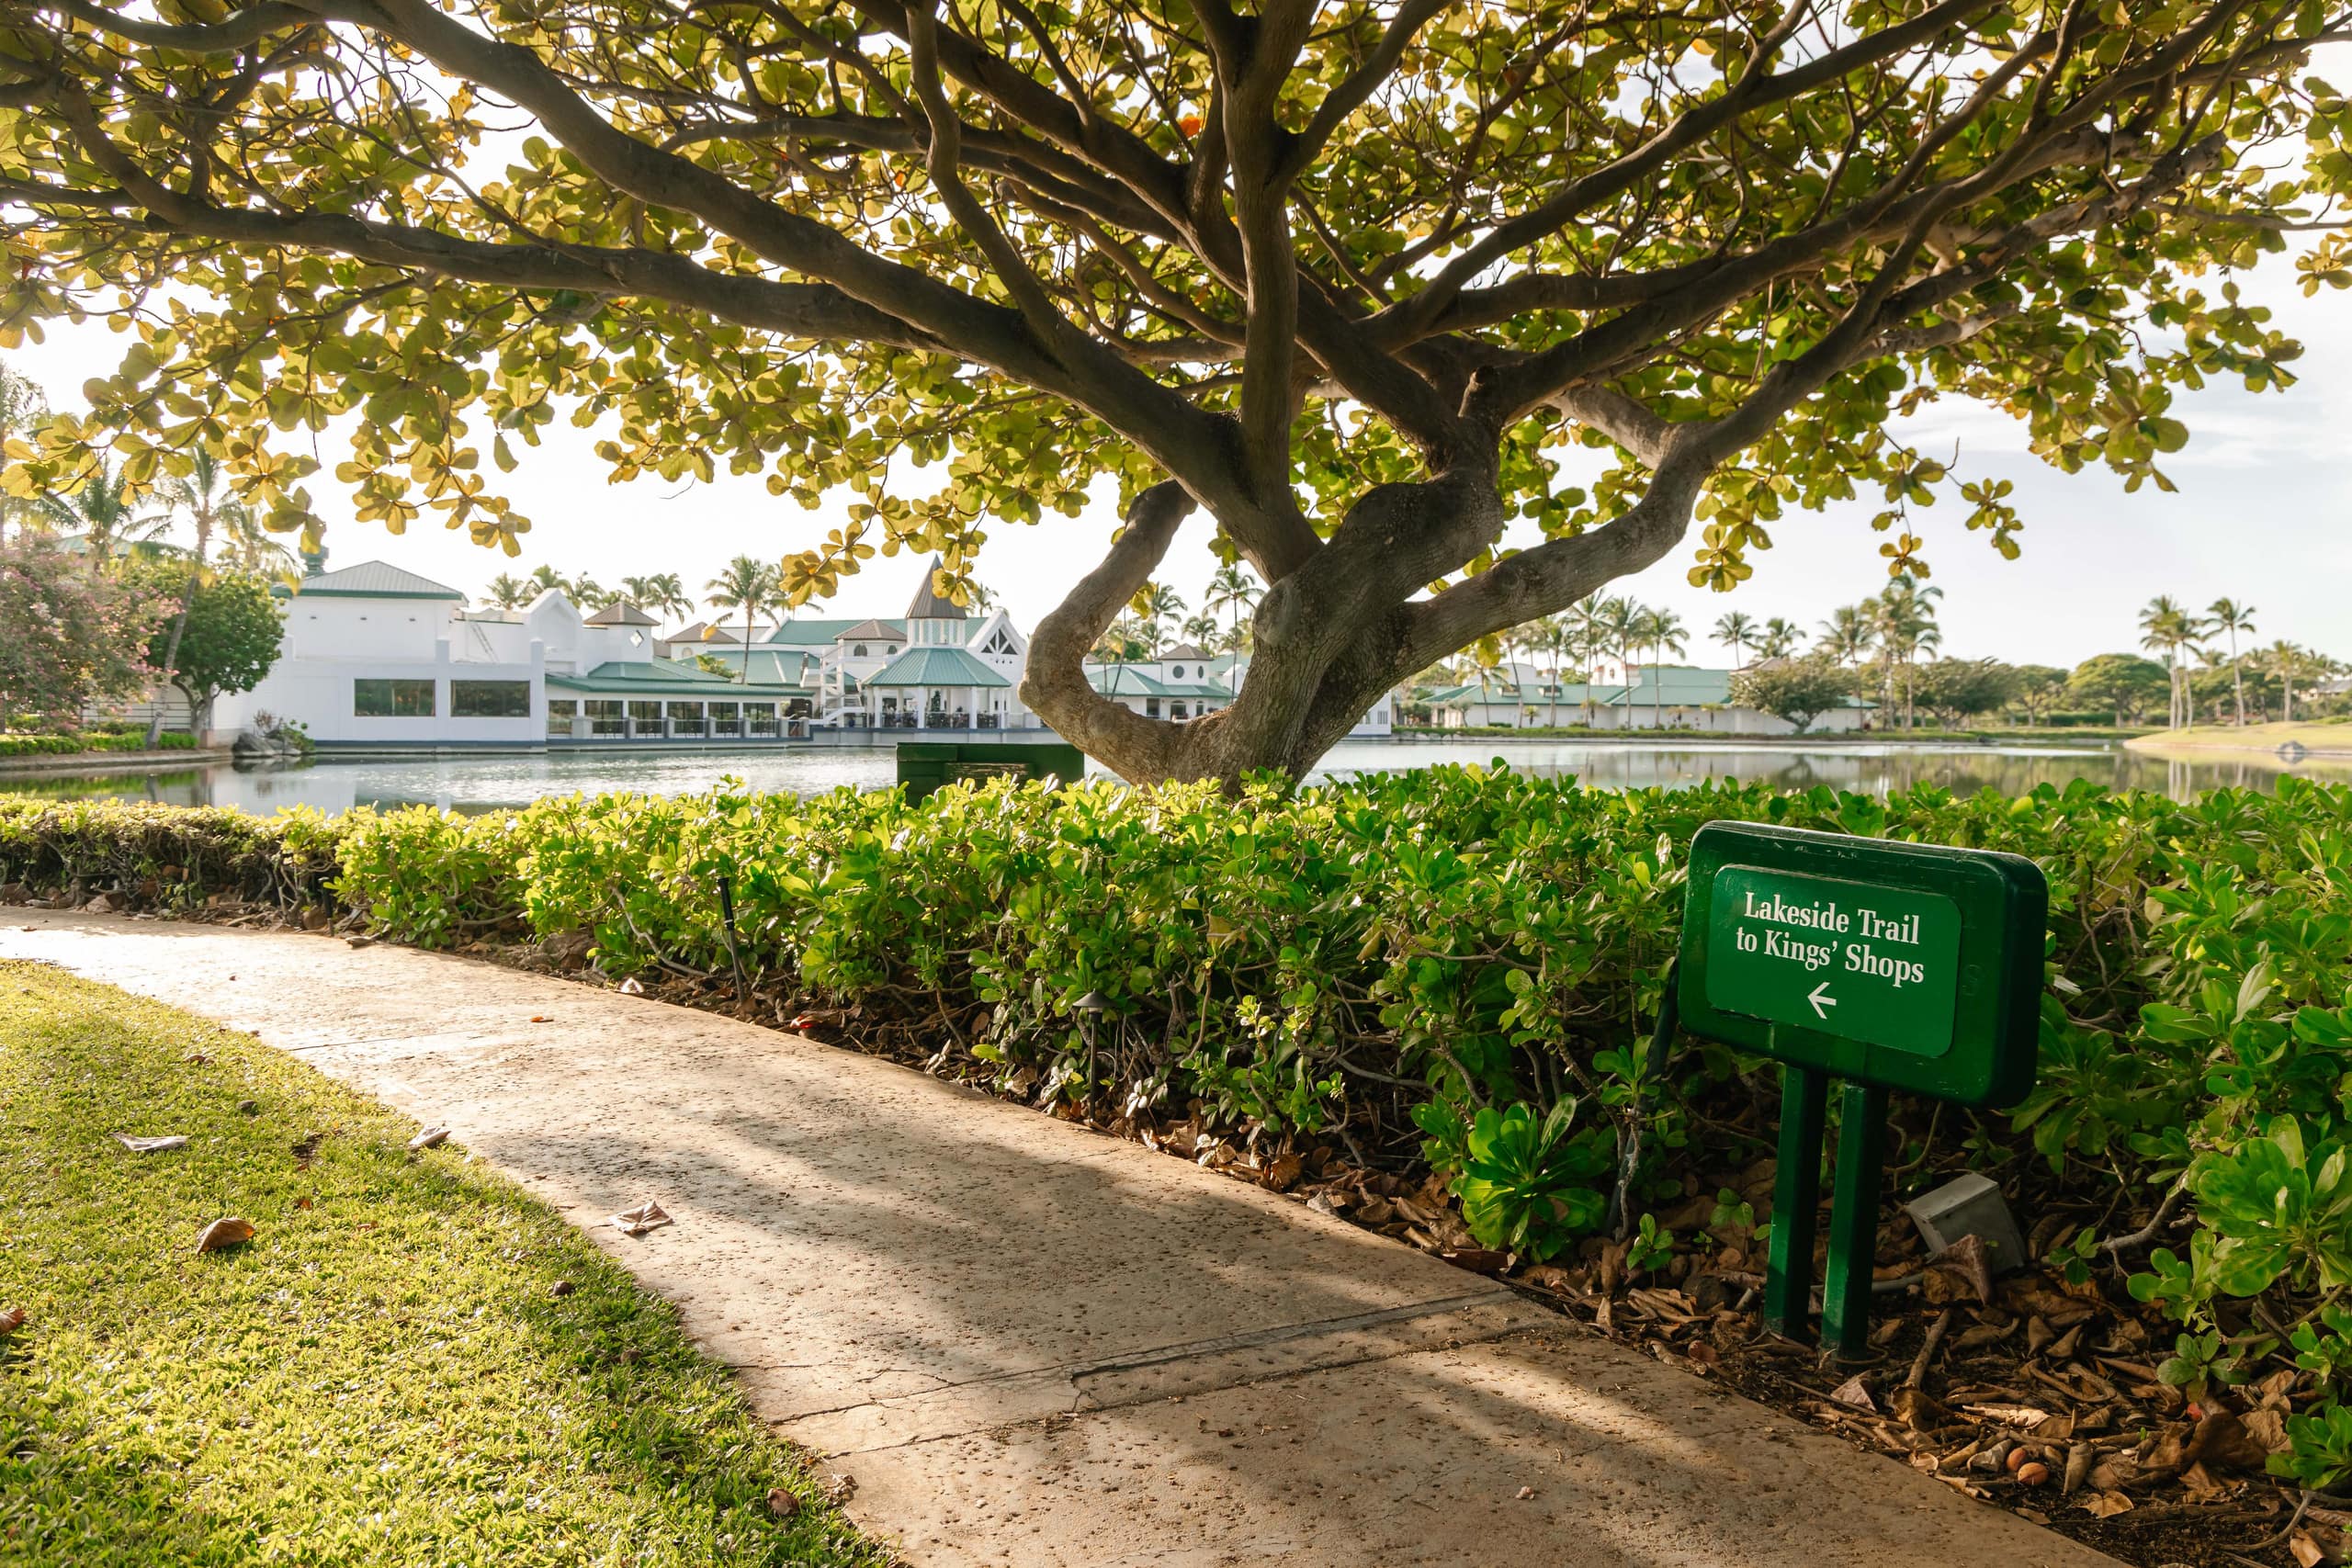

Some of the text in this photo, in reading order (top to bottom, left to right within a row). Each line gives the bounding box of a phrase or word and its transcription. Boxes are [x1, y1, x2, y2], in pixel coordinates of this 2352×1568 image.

[1744, 891, 1919, 945] Lakeside Trail
[1736, 926, 1925, 988] to Kings' Shops
